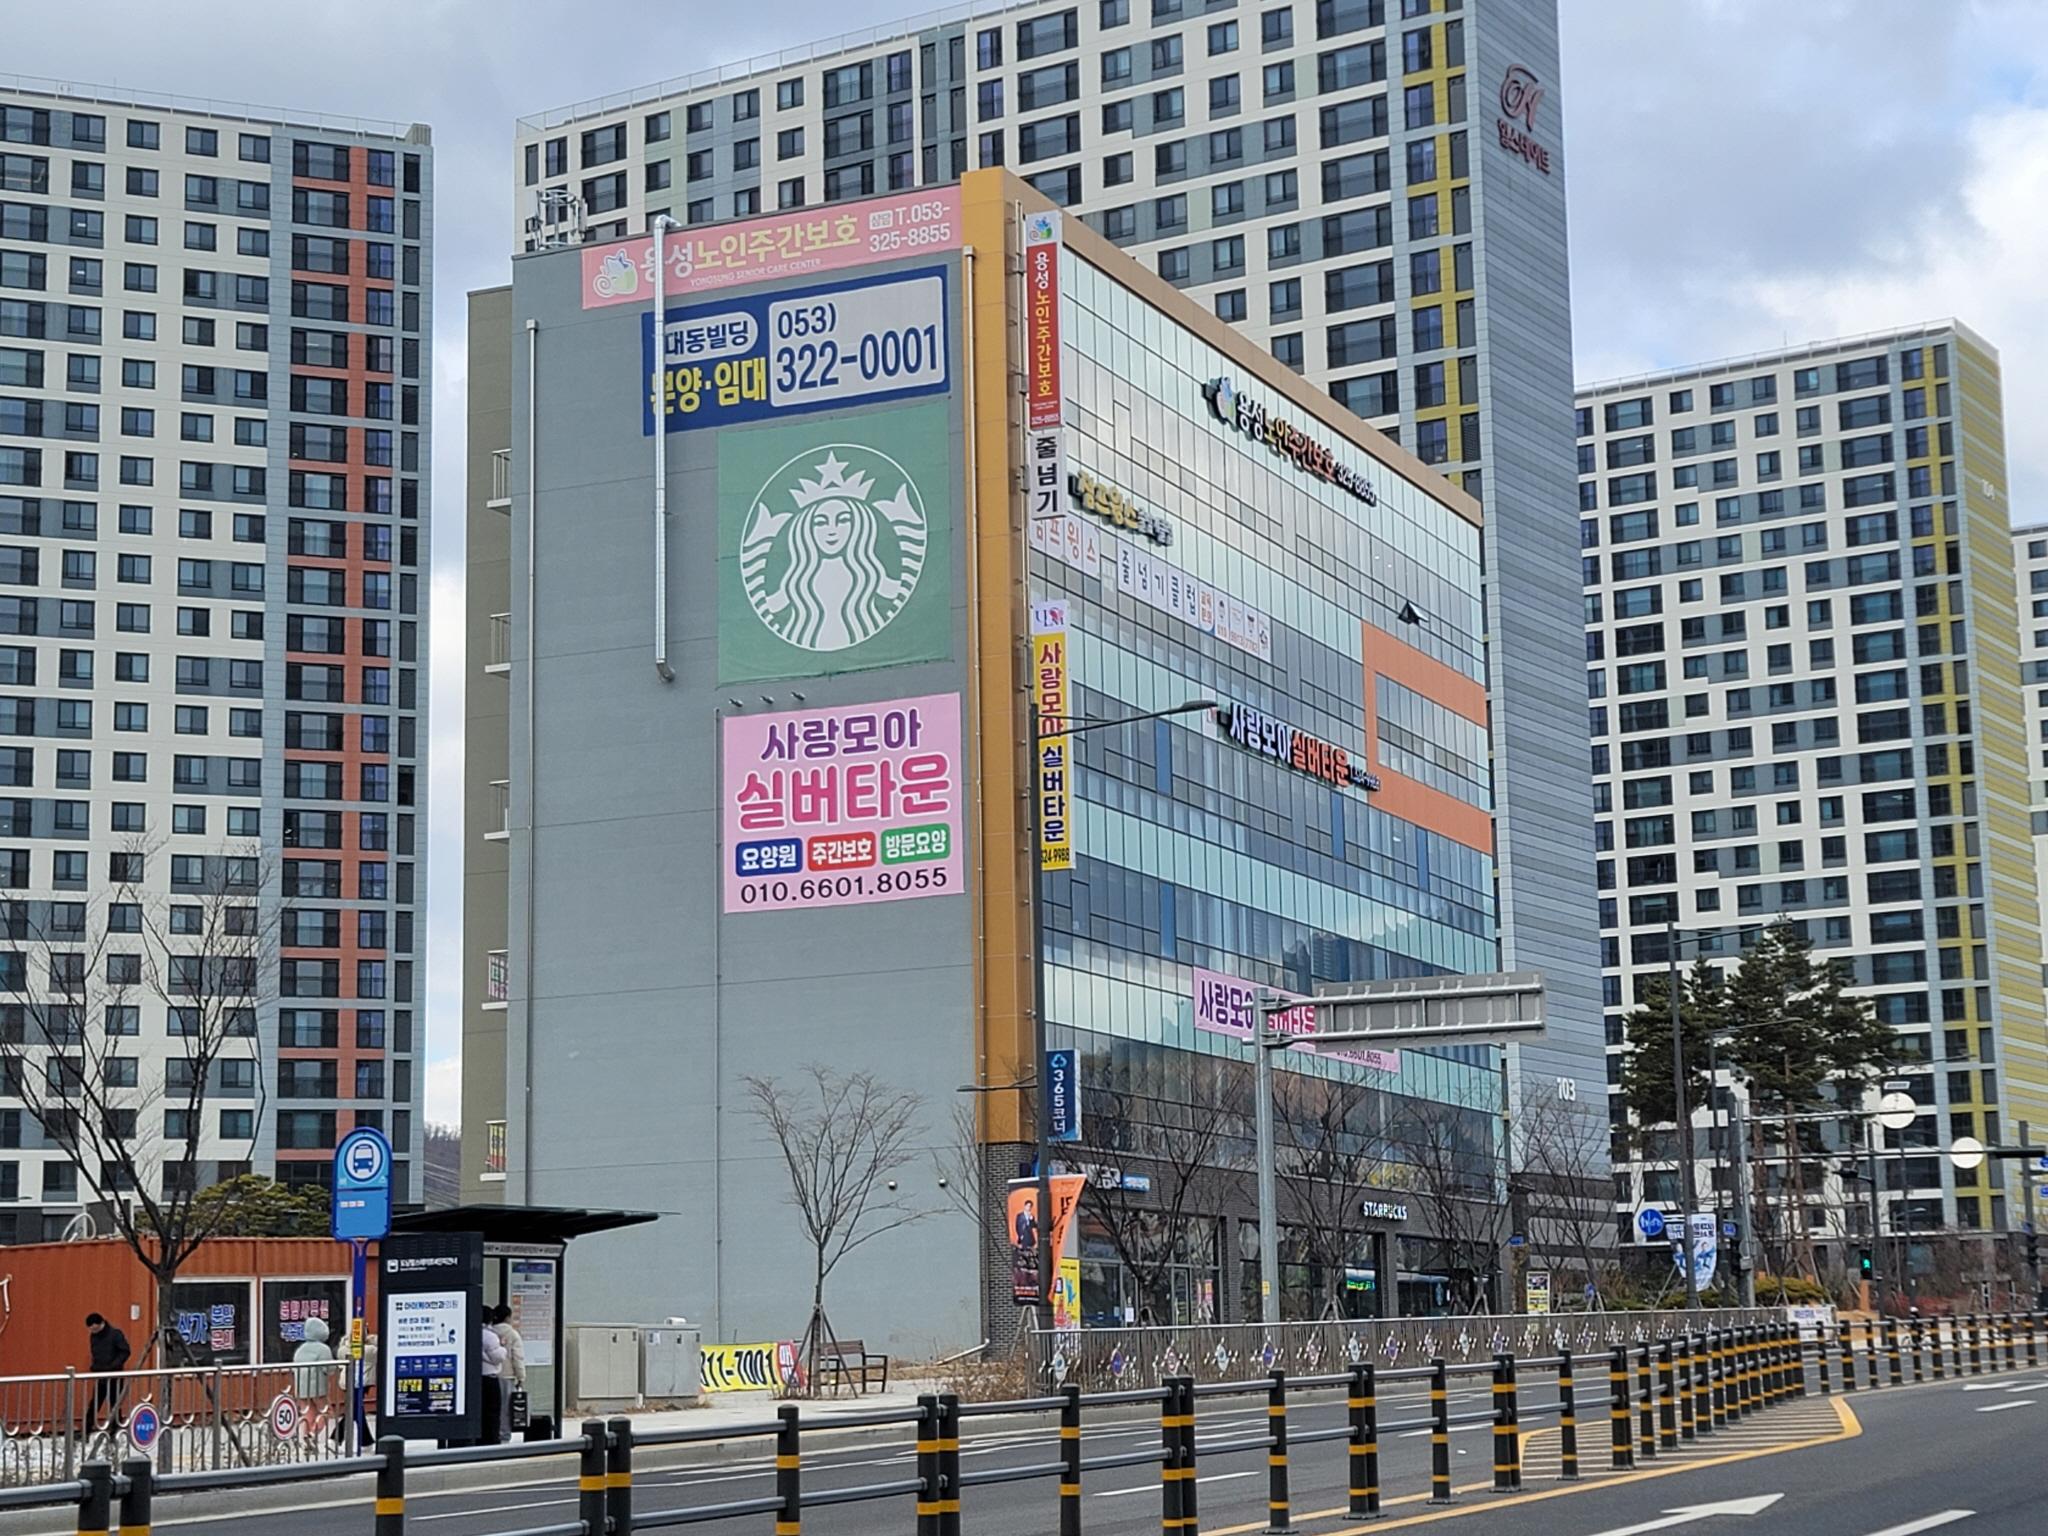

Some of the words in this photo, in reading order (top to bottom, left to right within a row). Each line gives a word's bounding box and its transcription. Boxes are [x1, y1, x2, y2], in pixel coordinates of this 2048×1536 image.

[895, 201, 951, 225] T.053-
[640, 213, 860, 283] 용성노인주간보호
[869, 222, 951, 253] 325-8855
[690, 271, 735, 288] YONGSUNG
[736, 267, 766, 280] SENIOR
[766, 263, 788, 276] CARE
[789, 258, 821, 272] CENTER
[665, 320, 749, 356] 대동빌딩
[777, 302, 837, 339] 053)
[1034, 251, 1054, 398] 용성노인주간보호
[776, 324, 939, 393] 322-0001
[1237, 390, 1337, 484] 용성노인주간보호
[1035, 436, 1059, 514] 줄넘기
[1121, 549, 1197, 616] 줄넘기클럽
[761, 708, 922, 761] 사랑모아
[1229, 701, 1350, 788] 사랑모아실버타운
[736, 753, 950, 832] 실버타운
[1041, 745, 1066, 843] 실버타운
[741, 843, 798, 871] 요양원
[811, 837, 873, 866] 주간보호
[884, 829, 947, 858] 방문요양
[740, 866, 948, 904] 010.6601.8055
[1053, 1068, 1067, 1134] 365코너
[1556, 1076, 1576, 1102] 103
[178, 1312, 209, 1345] 상가
[210, 1303, 236, 1327] 분양
[278, 1409, 292, 1426] 50
